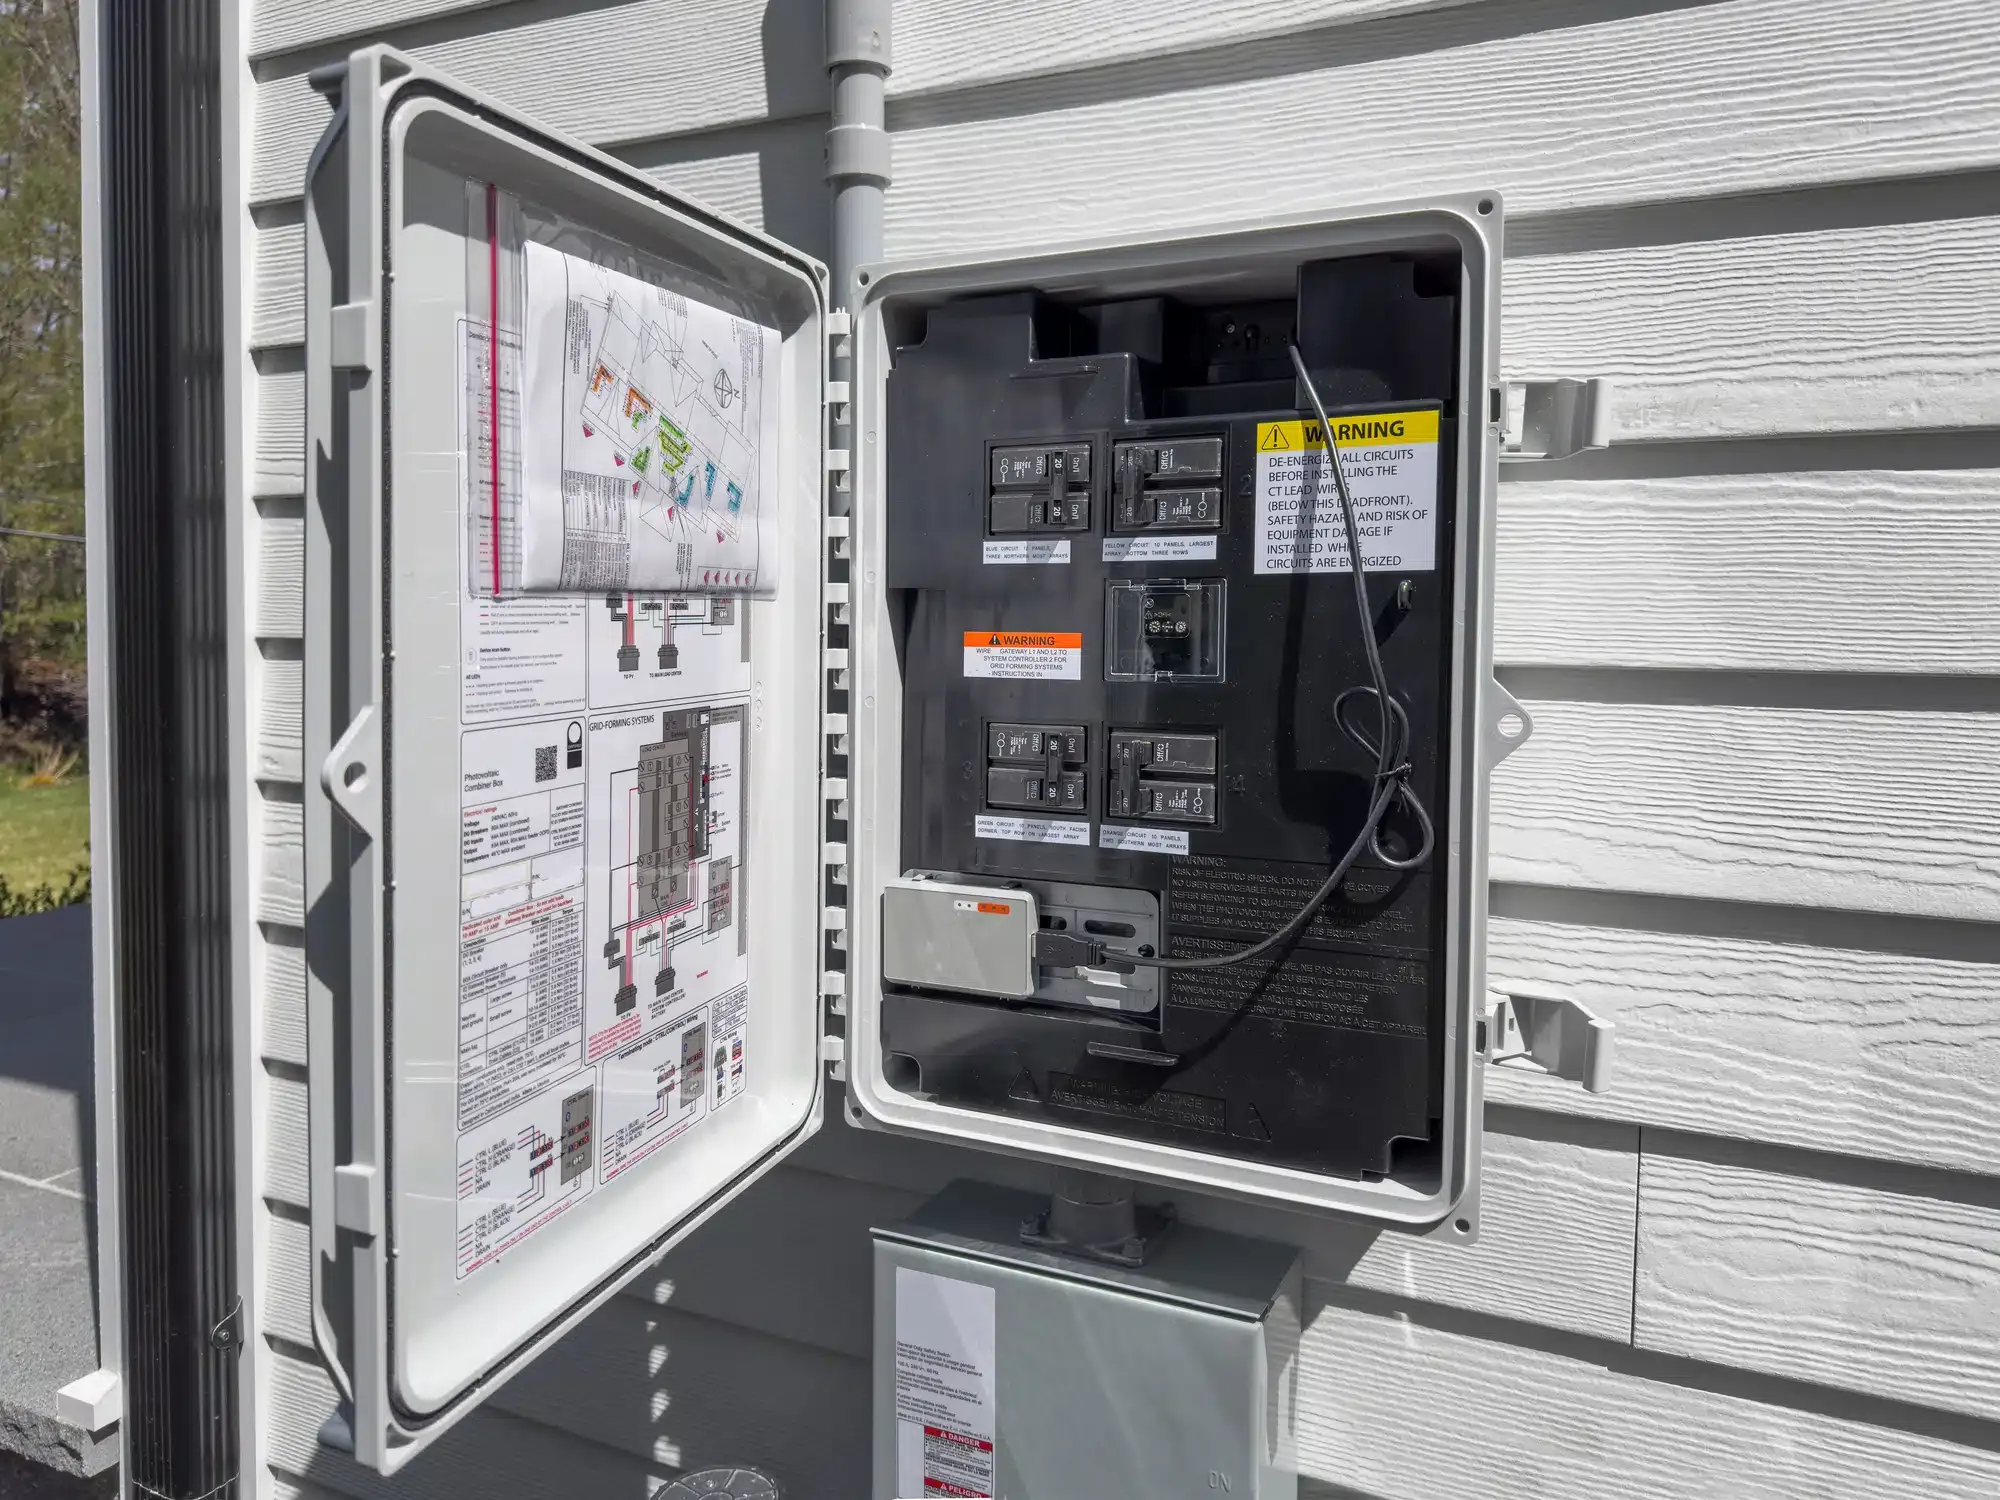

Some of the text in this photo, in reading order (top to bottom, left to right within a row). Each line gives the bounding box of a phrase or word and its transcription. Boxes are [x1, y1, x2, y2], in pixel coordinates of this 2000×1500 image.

[1055, 458, 1062, 468] 20
[1128, 457, 1133, 466] 20
[1269, 449, 1414, 468] DE-ENERGIZ ALL CIRCUITS
[1269, 465, 1398, 481] BEFORE INSTLLING THE
[1268, 483, 1350, 497] CT LEAD WIRS
[1053, 507, 1060, 516] 20
[1127, 506, 1132, 517] 20
[1268, 499, 1309, 512] (BELOW
[1310, 498, 1334, 510] THIS
[1268, 514, 1307, 525] SAFETY
[1358, 511, 1383, 521] AND
[1386, 510, 1410, 520] RISK
[1412, 509, 1428, 520] OF
[1268, 528, 1330, 540] EQUIPMENT
[1384, 526, 1393, 536] IF
[1267, 543, 1323, 554] INSTALLED
[1267, 555, 1402, 569] CIRCUITS ARE ENRGIZED
[1004, 636, 1055, 646] WARNING
[589, 715, 654, 731] GRID-FORMING SYSTEMS
[1051, 740, 1058, 750] 20
[1124, 748, 1129, 758] 20
[464, 770, 499, 782] Photovoltaic
[464, 782, 492, 792] Combiner
[1050, 787, 1056, 798] 20
[1123, 798, 1128, 808] 20
[1172, 855, 1227, 868] WARNING:
[1172, 868, 1191, 876] RISK
[1205, 870, 1246, 881] ELECTRIC
[1281, 876, 1294, 885] DO
[1297, 879, 1315, 887] NOT
[1186, 880, 1207, 889] USER
[1210, 882, 1266, 894] SERVICEABLE
[1268, 888, 1296, 897] PARTS
[1172, 890, 1198, 900] REFER
[1200, 892, 1245, 904] SERVICING
[1260, 898, 1305, 910] QUALIFIED
[1172, 901, 1280, 919] WHEN THE PHOTOVOLTAIC
[1181, 914, 1219, 925] SUPPLIES
[1305, 926, 1324, 936] THIS
[1301, 964, 1370, 979] NE PAS OUVRIR
[1172, 972, 1218, 984] CONSULTER
[1354, 994, 1368, 1003] LES
[1295, 975, 1334, 987] SERVICE
[948, 1433, 980, 1447] DANGER
[1208, 1470, 1232, 1493] ON
